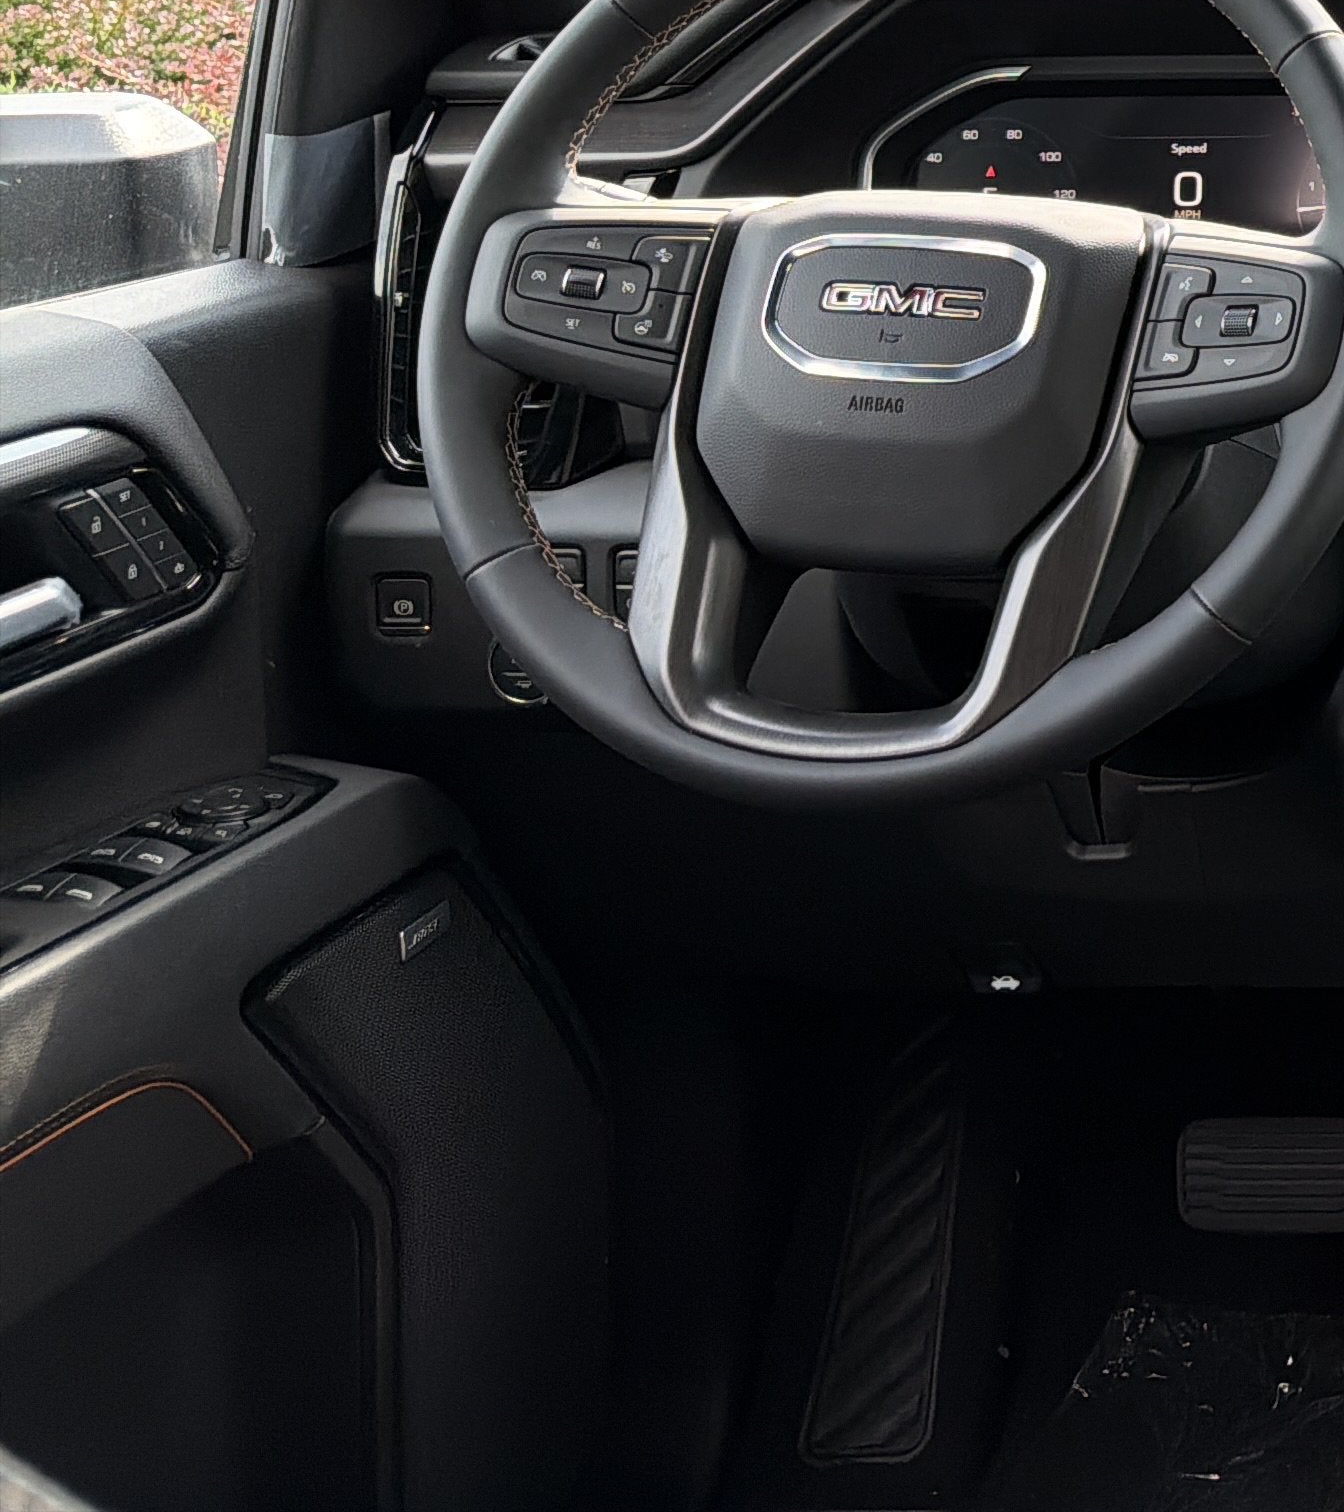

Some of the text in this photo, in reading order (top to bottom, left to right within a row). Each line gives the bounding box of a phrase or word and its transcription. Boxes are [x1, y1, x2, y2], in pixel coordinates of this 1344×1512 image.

[963, 130, 978, 140] 60
[1006, 130, 1022, 140] 80
[1171, 143, 1208, 157] Speed
[926, 153, 943, 163] 40
[1039, 152, 1062, 162] 100
[1053, 189, 1076, 199] 120
[1173, 171, 1203, 207] 0
[1174, 210, 1201, 219] MPH
[822, 282, 985, 320] GMC
[565, 317, 581, 328] SET
[847, 395, 905, 414] AIRBAG
